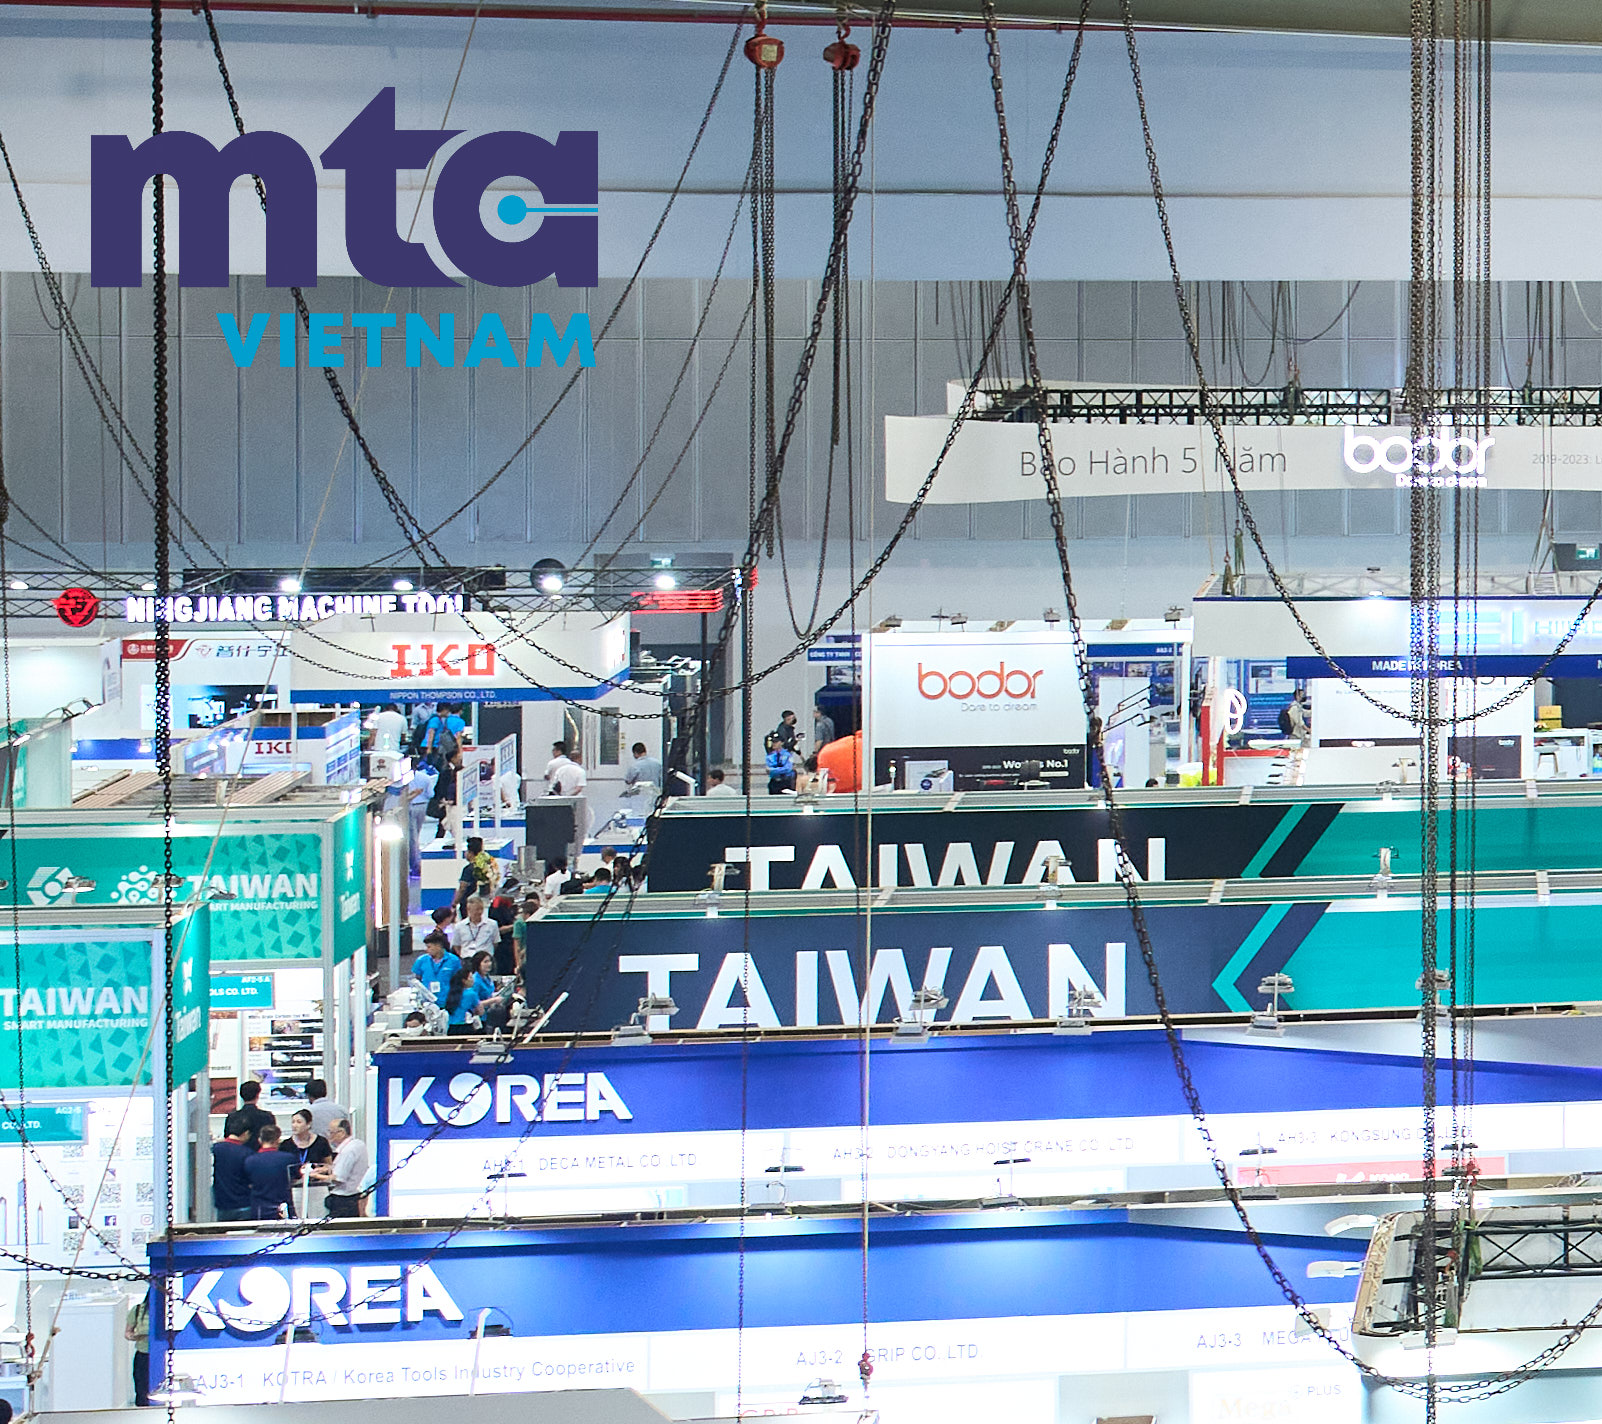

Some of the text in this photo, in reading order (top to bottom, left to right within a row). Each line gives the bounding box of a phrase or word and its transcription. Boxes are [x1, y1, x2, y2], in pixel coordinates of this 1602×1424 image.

[1089, 446, 1198, 477] Hành 5
[390, 643, 496, 678] IKO
[918, 661, 1043, 700] bodor
[726, 836, 1167, 890] TAIWAN
[183, 872, 318, 901] TAIWAN
[230, 900, 319, 913] MANUFACTURING
[0, 985, 149, 1017] TAIWAN
[618, 941, 1127, 1032] TAIWAN
[3, 1016, 149, 1032] SMART MANUFACTURING
[388, 1071, 634, 1127] KOREA
[165, 1264, 465, 1335] KOREA
